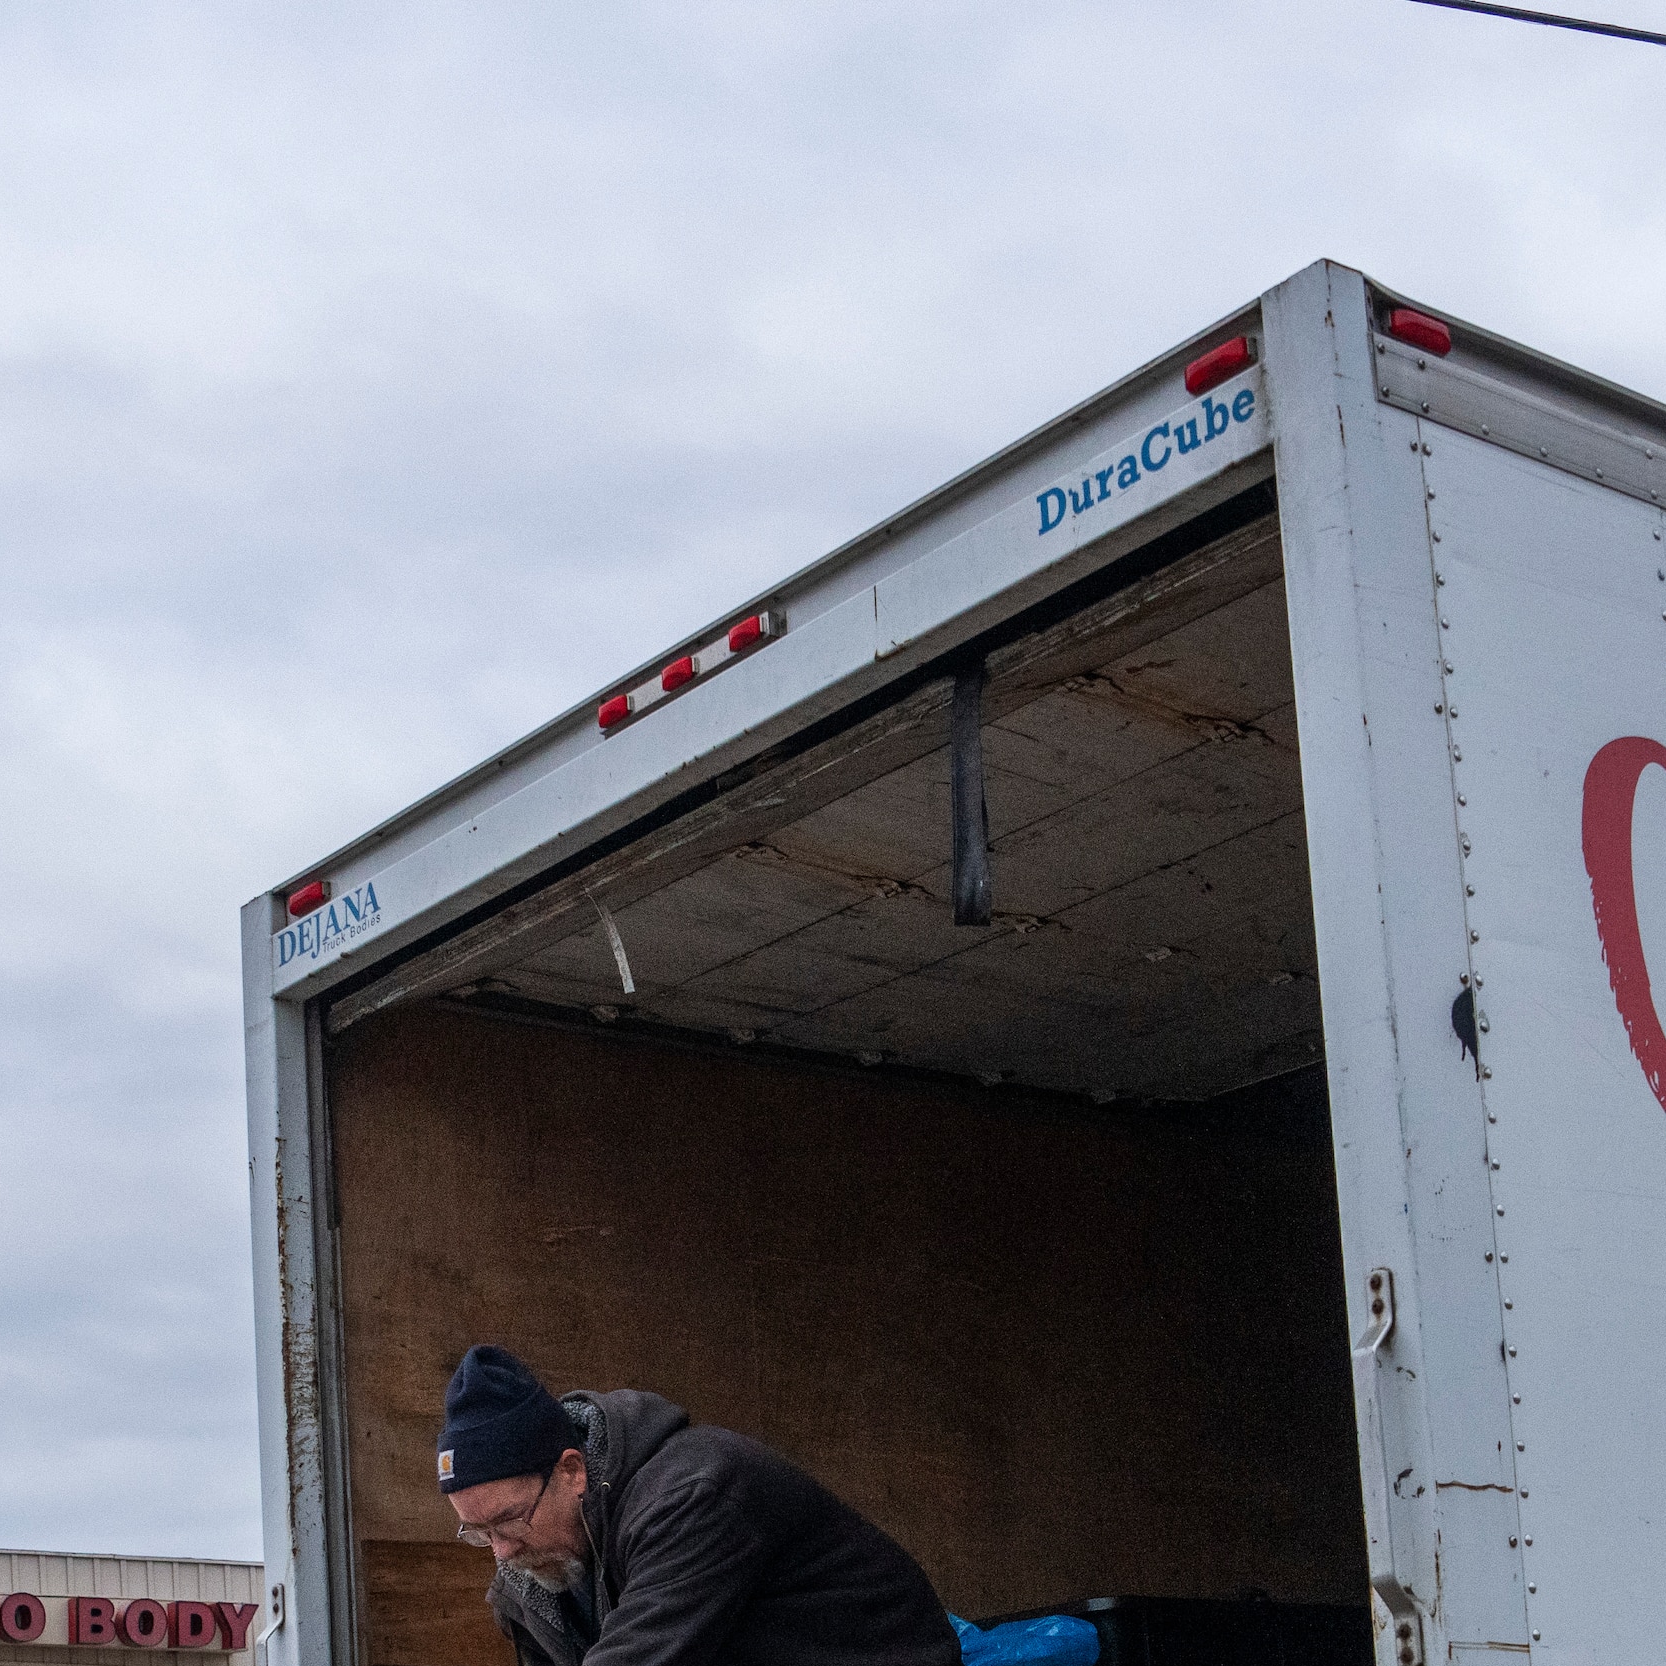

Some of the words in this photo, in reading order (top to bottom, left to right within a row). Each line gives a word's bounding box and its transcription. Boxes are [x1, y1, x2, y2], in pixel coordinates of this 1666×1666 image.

[1037, 384, 1258, 536] DuraCube
[278, 882, 381, 967] DEJANA
[323, 935, 346, 953] Truck
[350, 914, 381, 938] Bodies
[69, 1596, 259, 1650] BODY
